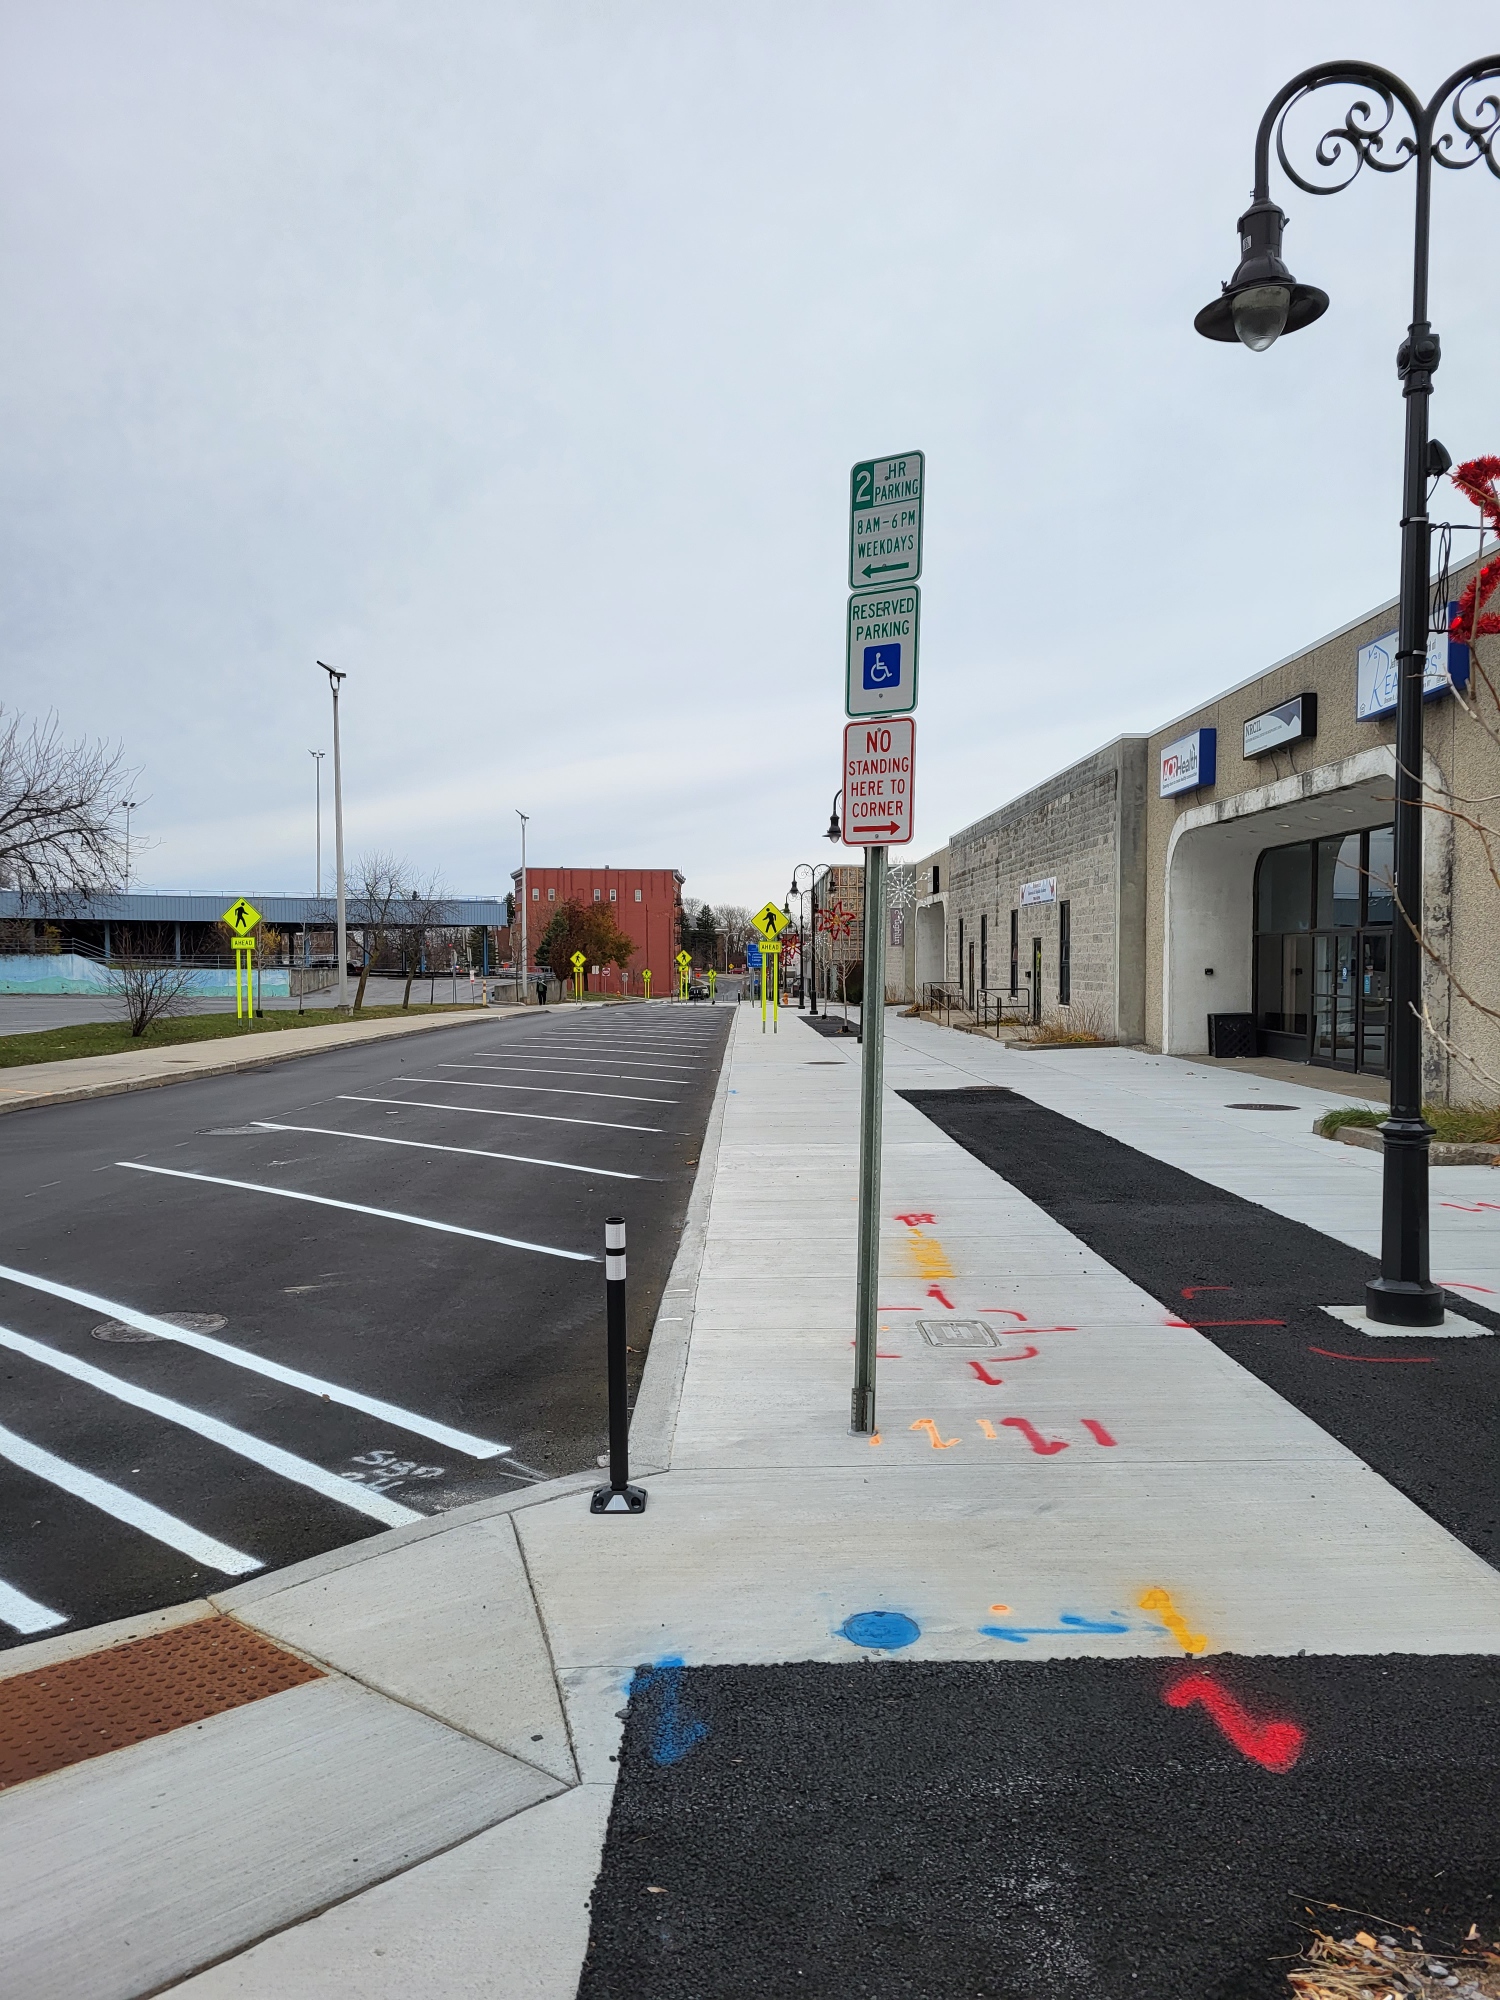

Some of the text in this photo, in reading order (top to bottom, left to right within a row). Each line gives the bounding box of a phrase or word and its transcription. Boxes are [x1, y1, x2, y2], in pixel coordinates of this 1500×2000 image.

[856, 461, 906, 503] 2 HR
[875, 479, 918, 502] PARKING
[858, 535, 914, 559] WEEKDAYS
[853, 597, 914, 620] RESERVED
[856, 620, 910, 641] PARKING
[866, 729, 892, 754] NO
[848, 757, 909, 776] STANDING
[850, 778, 905, 797] HERE TO
[852, 800, 903, 818] CORNER
